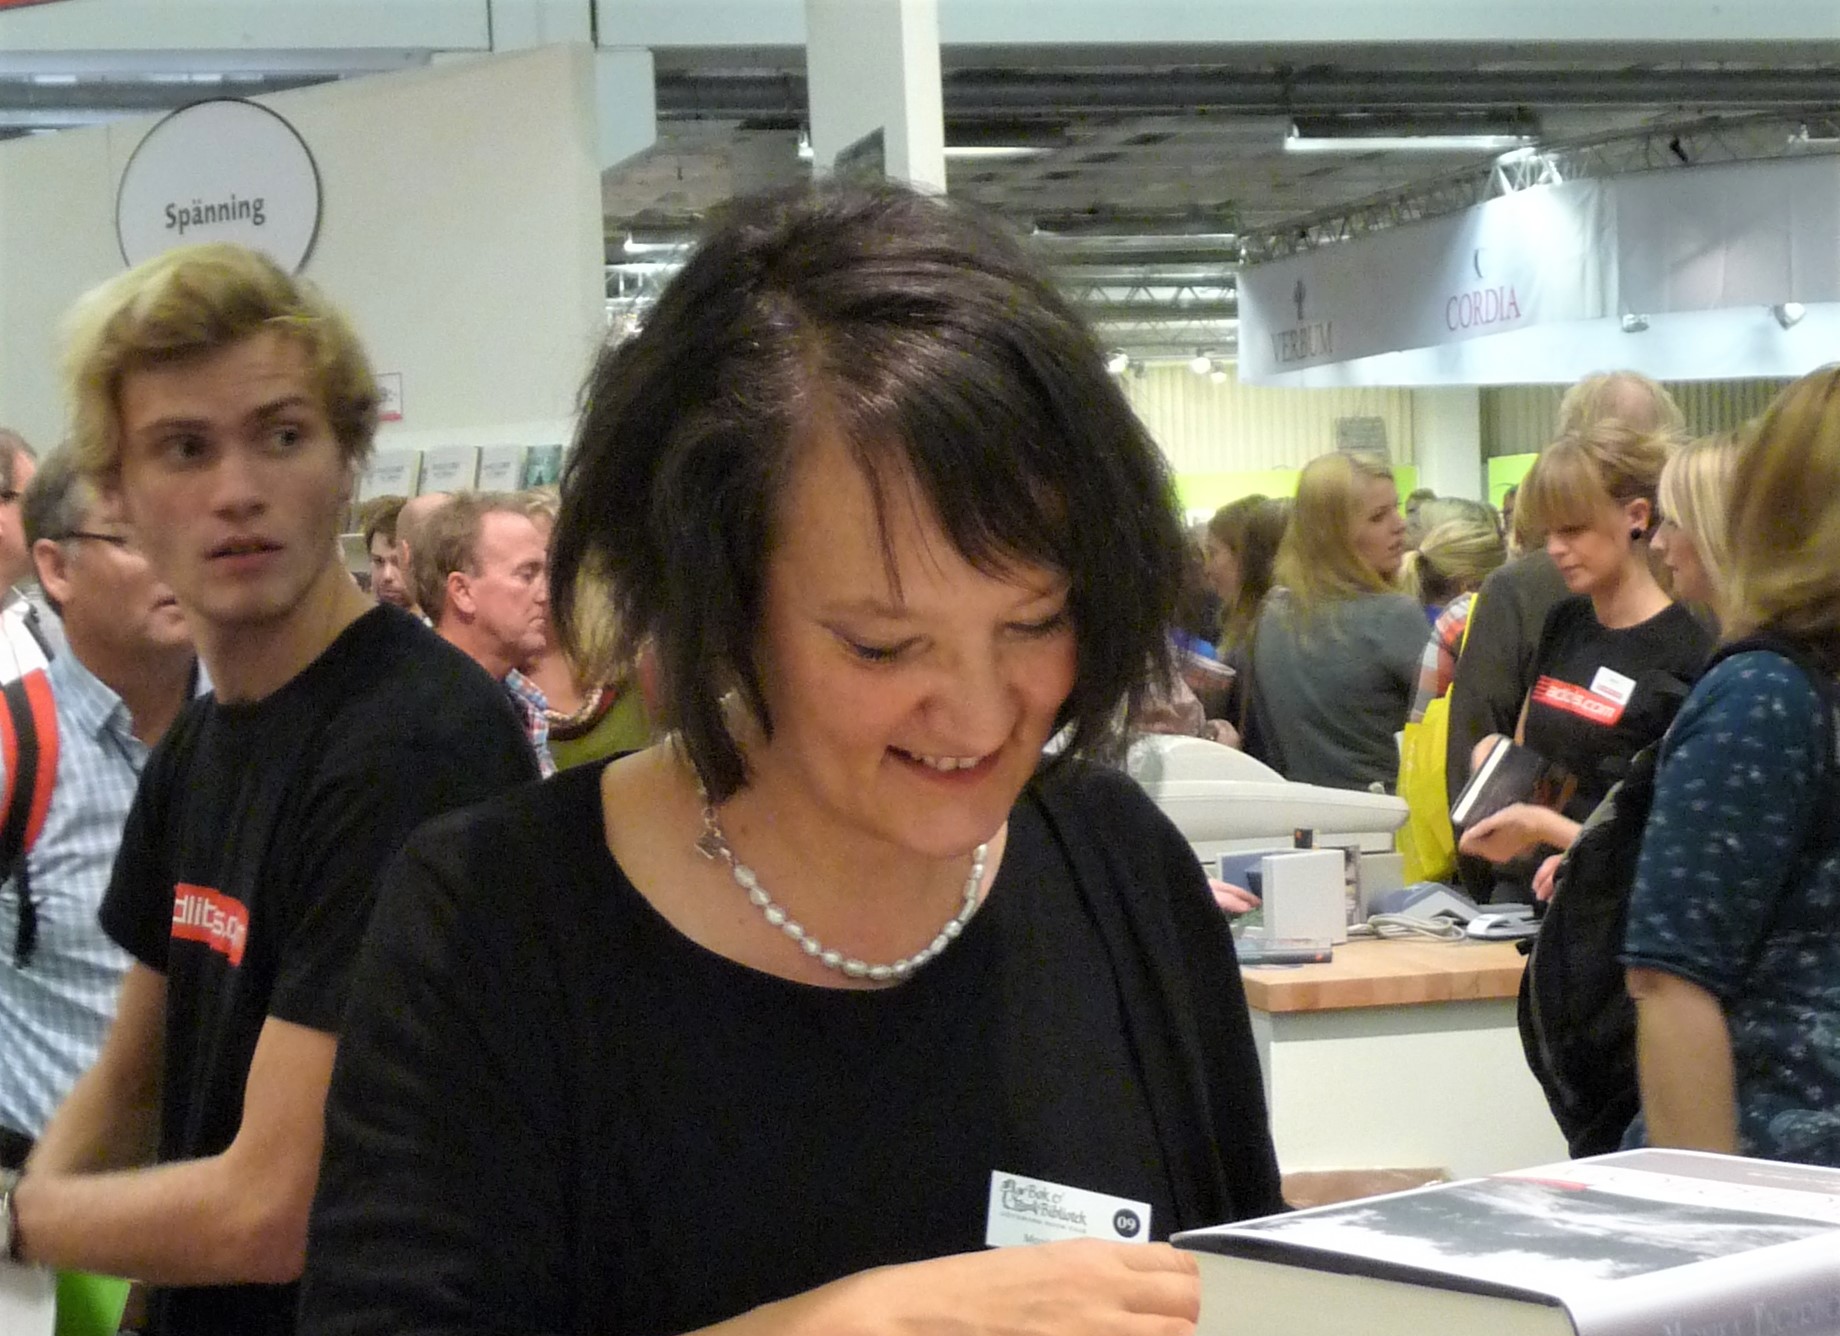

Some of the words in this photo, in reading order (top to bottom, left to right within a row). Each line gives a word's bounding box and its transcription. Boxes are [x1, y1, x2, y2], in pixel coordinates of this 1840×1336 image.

[165, 193, 266, 235] Spänning
[1445, 284, 1522, 332] CORDIA
[1271, 321, 1334, 362] VERBUM
[1116, 1215, 1137, 1231] 09
